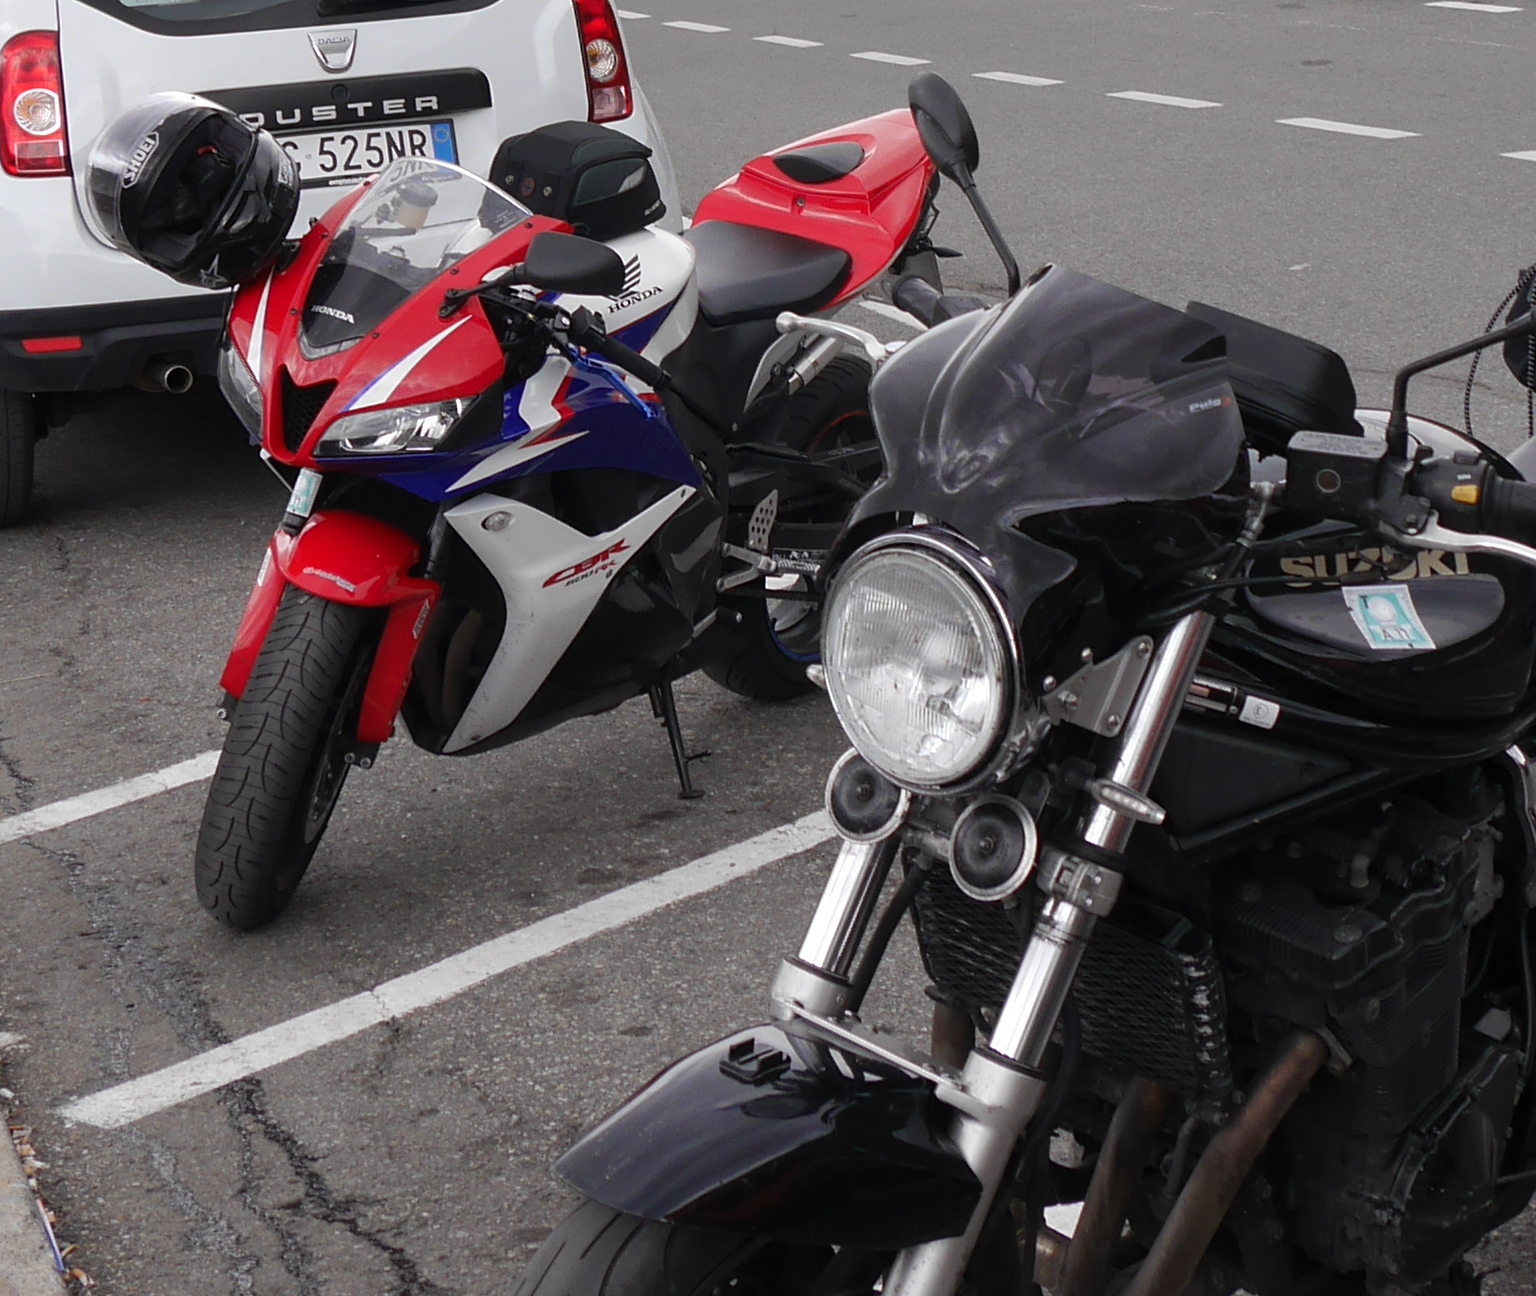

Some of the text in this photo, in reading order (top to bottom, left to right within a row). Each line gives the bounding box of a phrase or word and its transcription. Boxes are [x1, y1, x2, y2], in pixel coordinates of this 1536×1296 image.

[317, 36, 352, 46] DACIA
[123, 136, 157, 182] SHOEI
[607, 285, 664, 314] HONDA
[310, 304, 355, 324] HONDA
